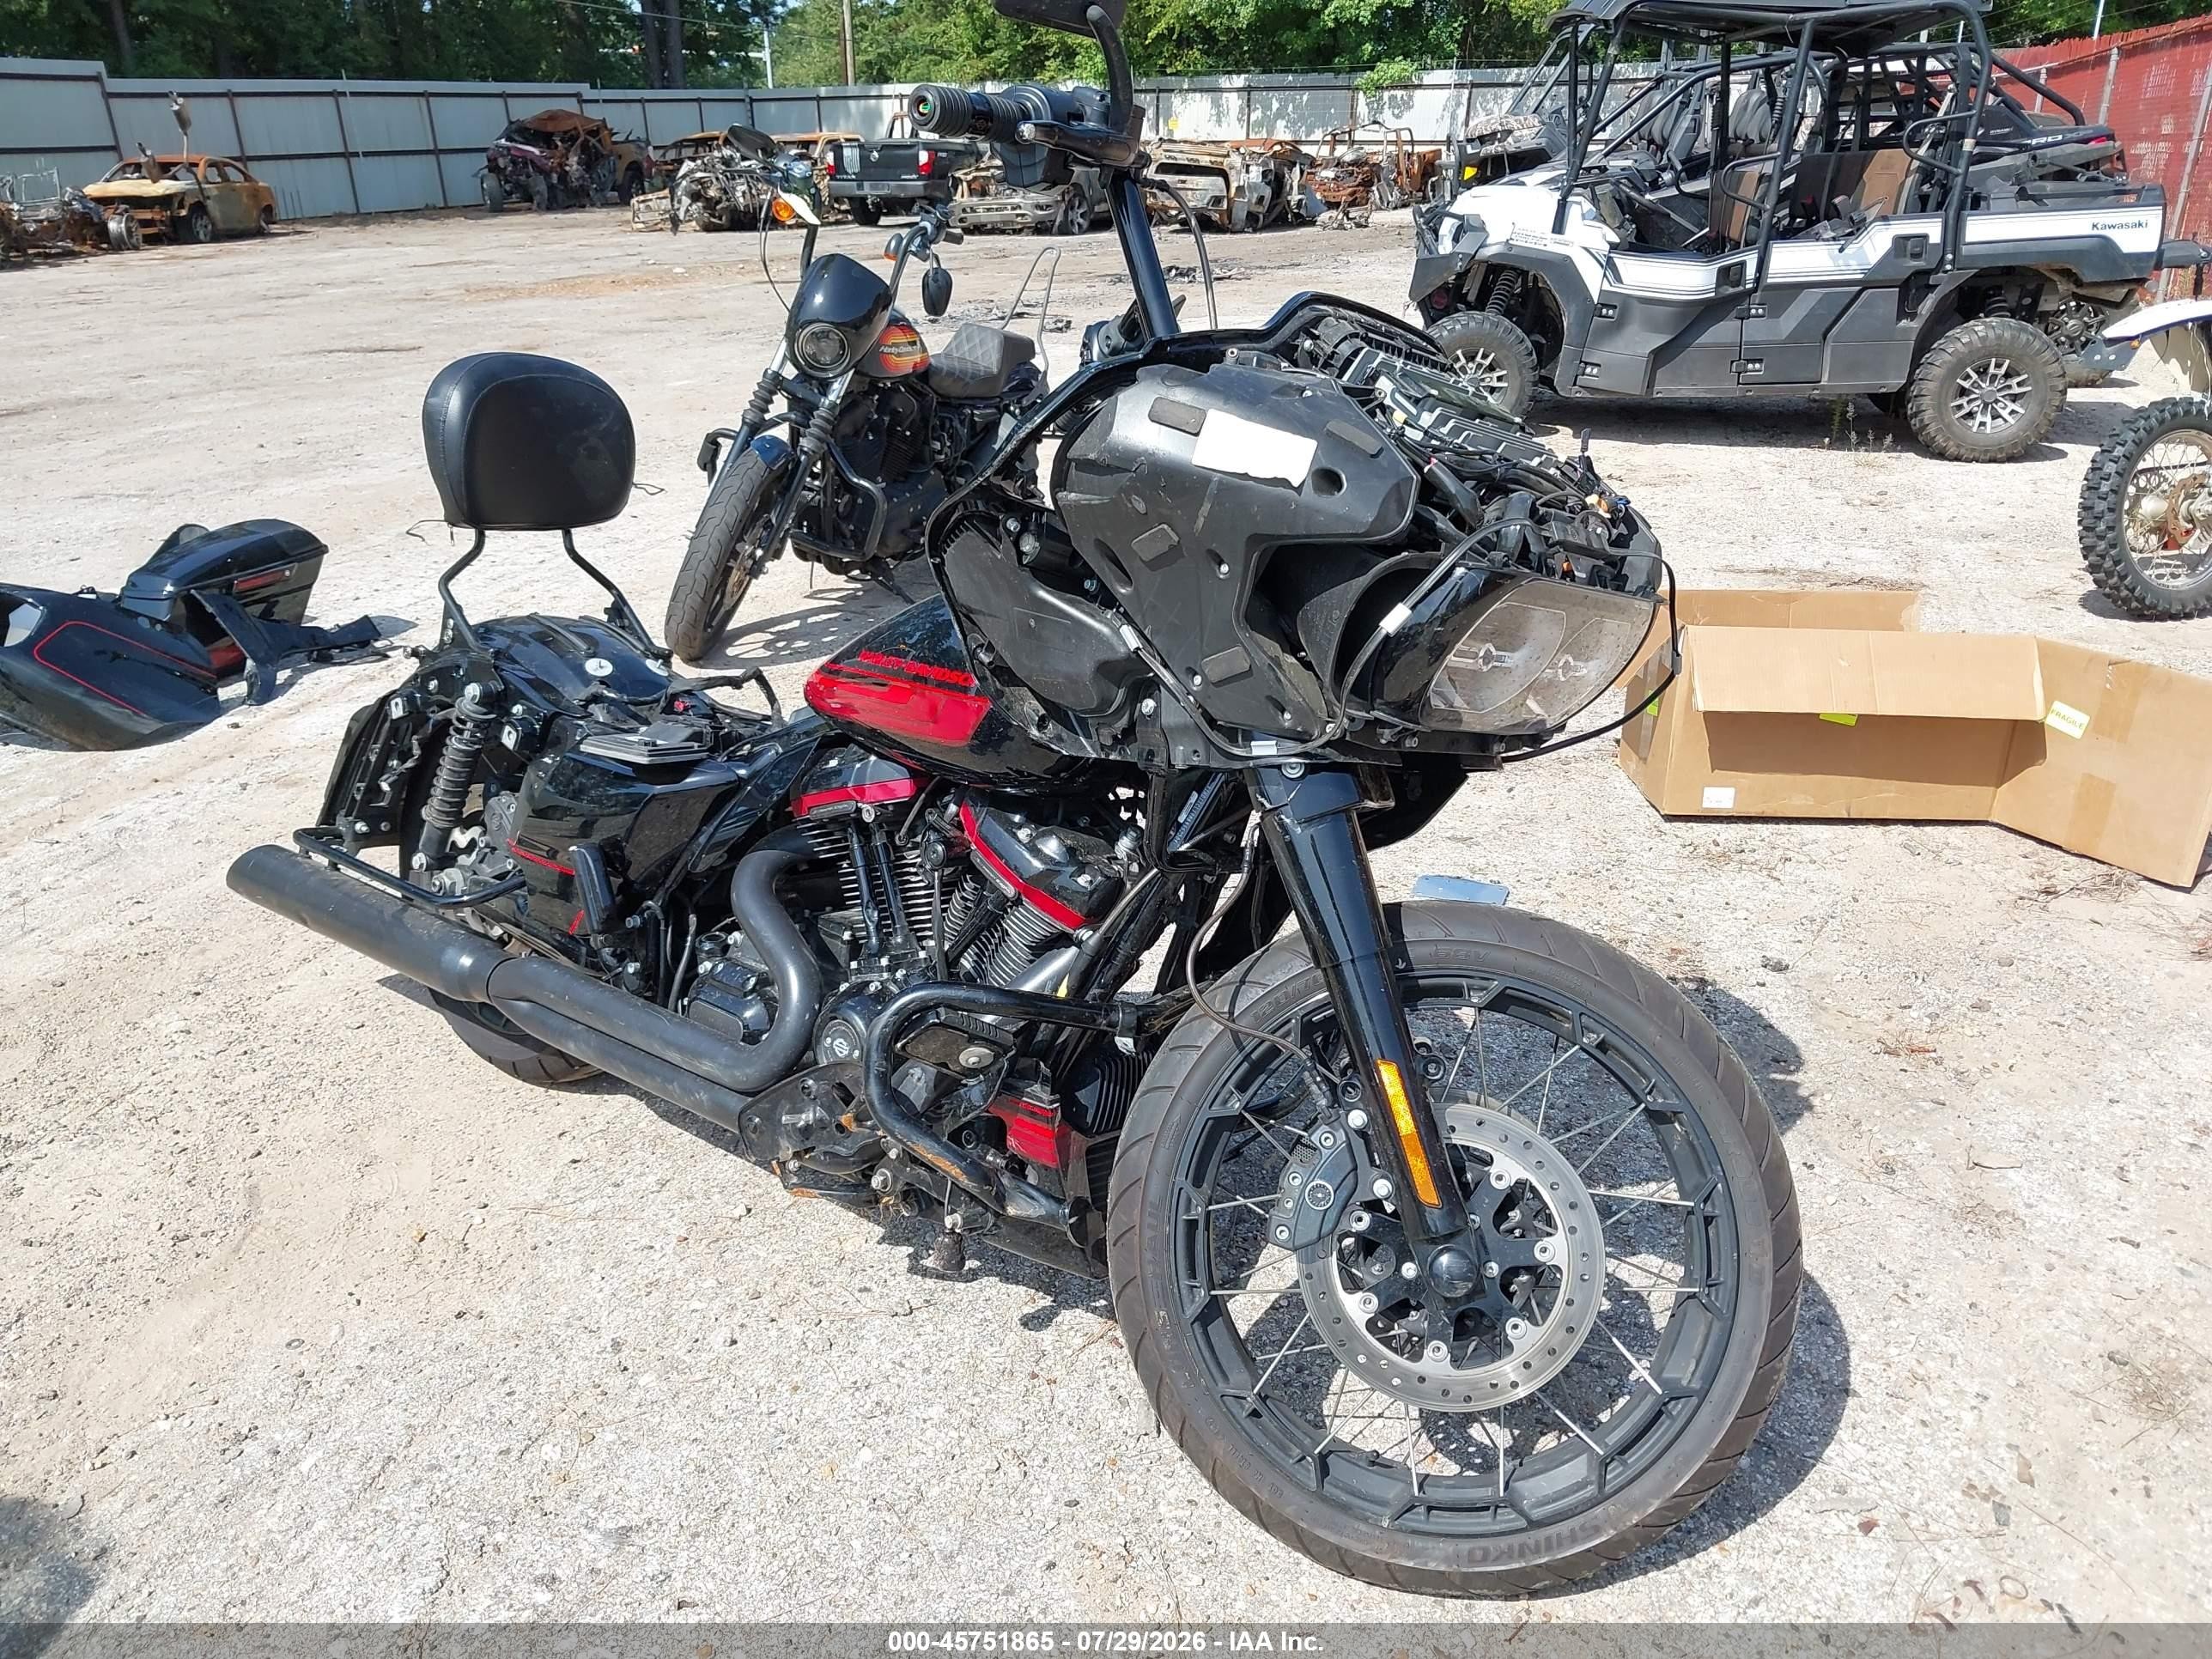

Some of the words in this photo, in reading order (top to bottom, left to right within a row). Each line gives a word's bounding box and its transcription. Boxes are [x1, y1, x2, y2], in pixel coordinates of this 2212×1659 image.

[2091, 219, 2148, 231] Kawasaki
[2051, 709, 2085, 730] FRAGILE
[1468, 1521, 1601, 1563] SHINKO
